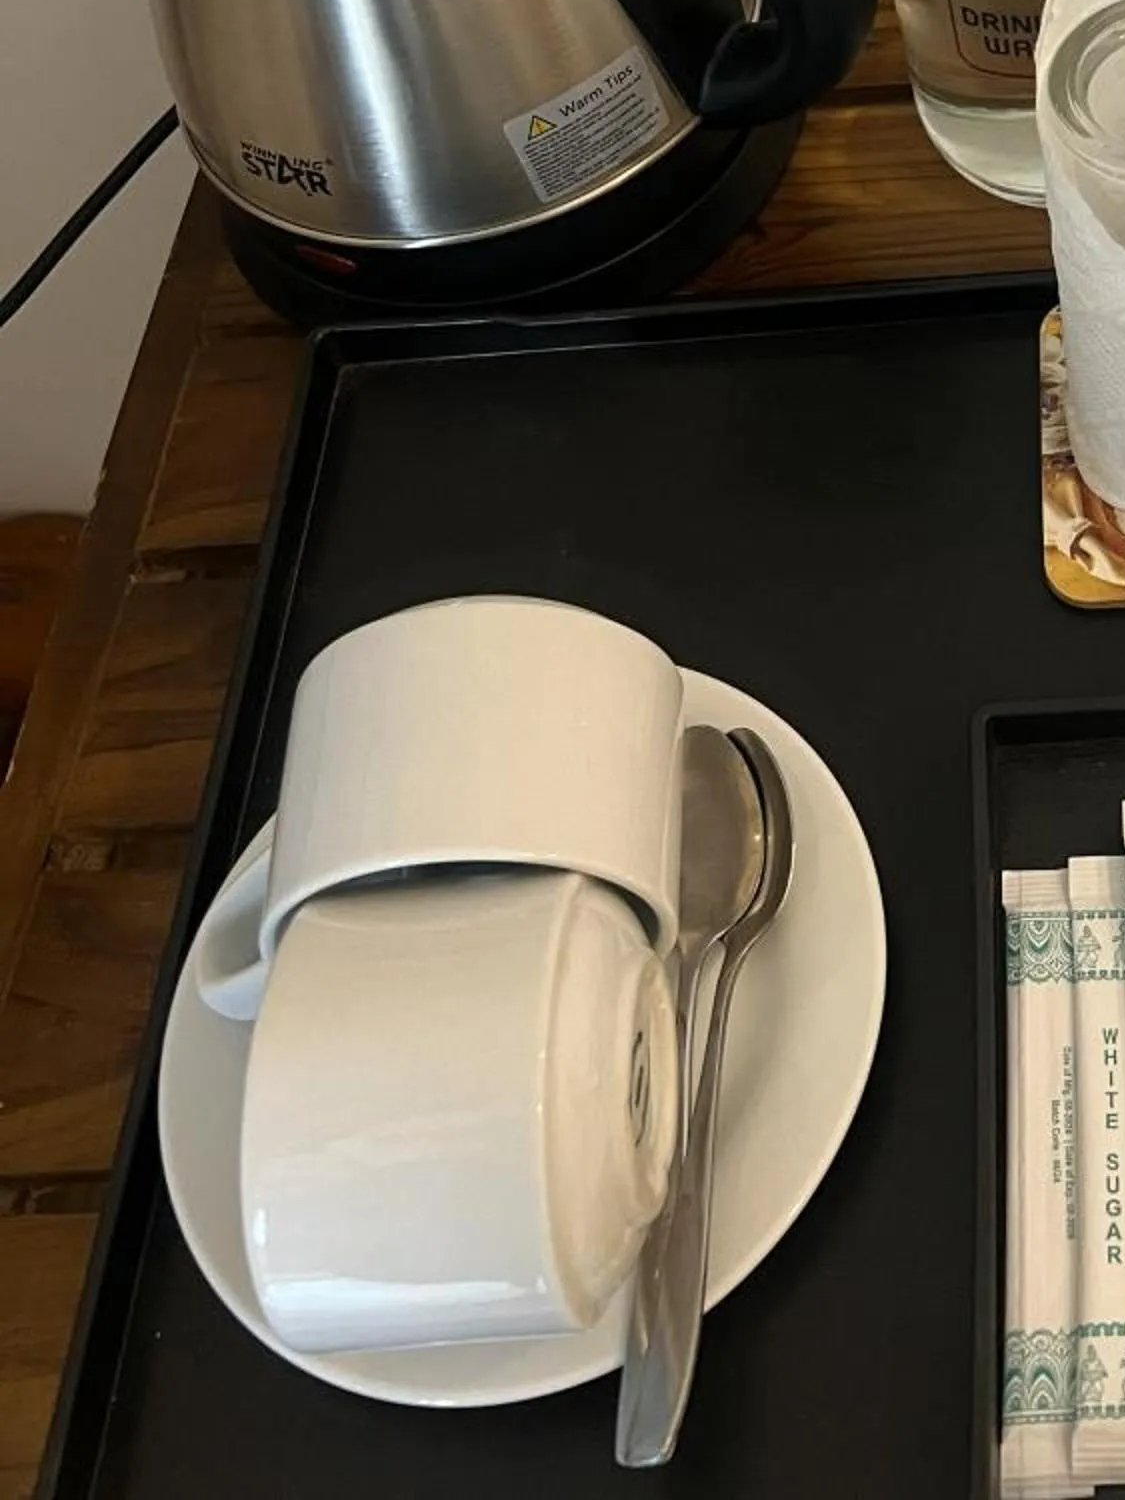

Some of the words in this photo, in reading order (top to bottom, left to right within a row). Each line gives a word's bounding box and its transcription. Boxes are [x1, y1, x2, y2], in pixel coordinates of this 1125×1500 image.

[960, 5, 1040, 34] DRIN
[559, 86, 604, 117] Warm
[604, 64, 633, 88] Tips
[1102, 1027, 1119, 1129] WHITE
[1104, 1152, 1123, 1265] SUGAR
